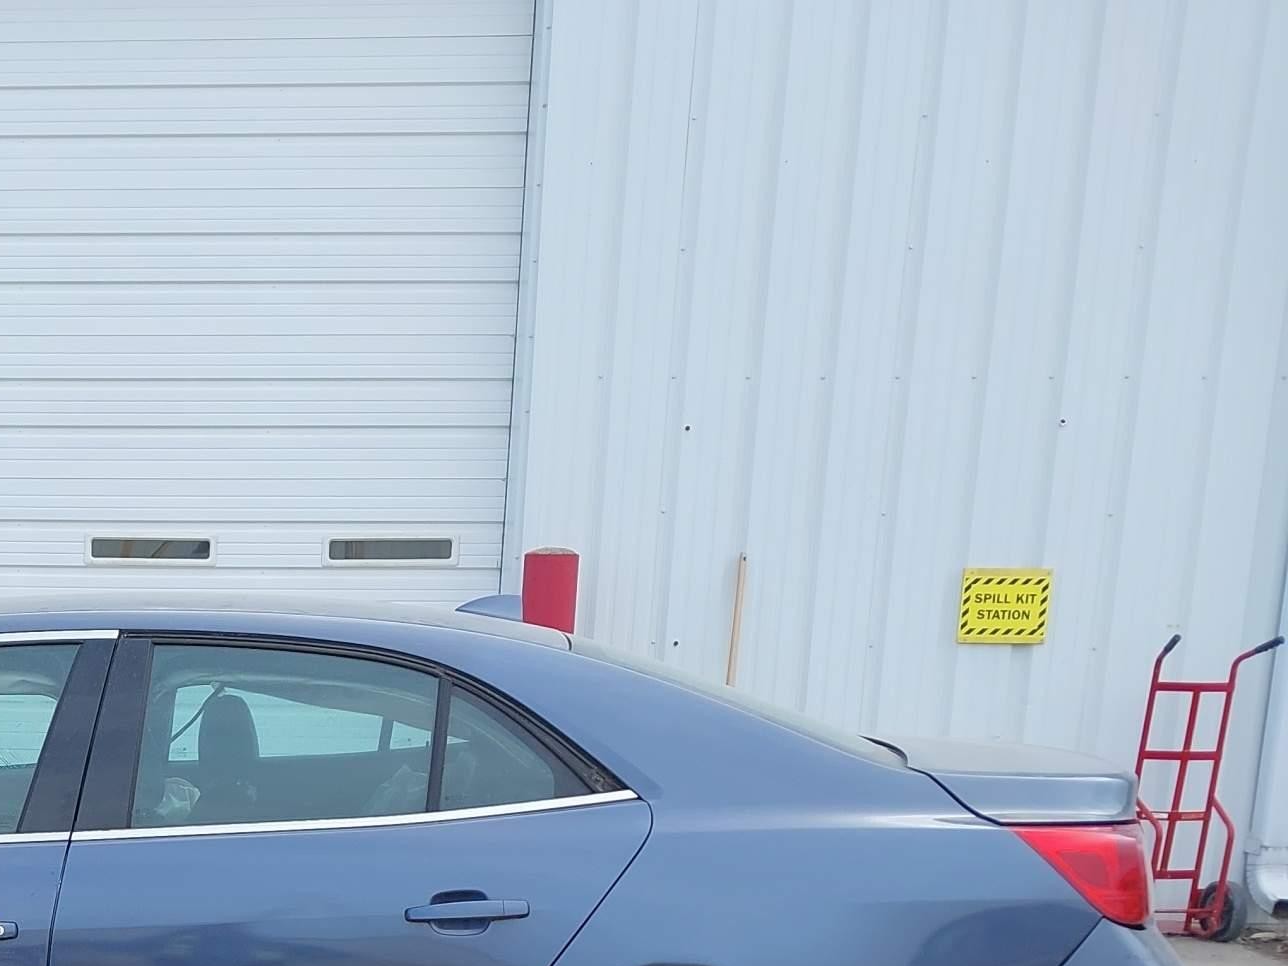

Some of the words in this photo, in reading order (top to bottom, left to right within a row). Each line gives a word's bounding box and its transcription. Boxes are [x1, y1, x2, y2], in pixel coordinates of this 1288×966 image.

[974, 593, 1011, 604] SPILL
[1015, 593, 1038, 604] KIT
[976, 609, 1031, 620] STATION
